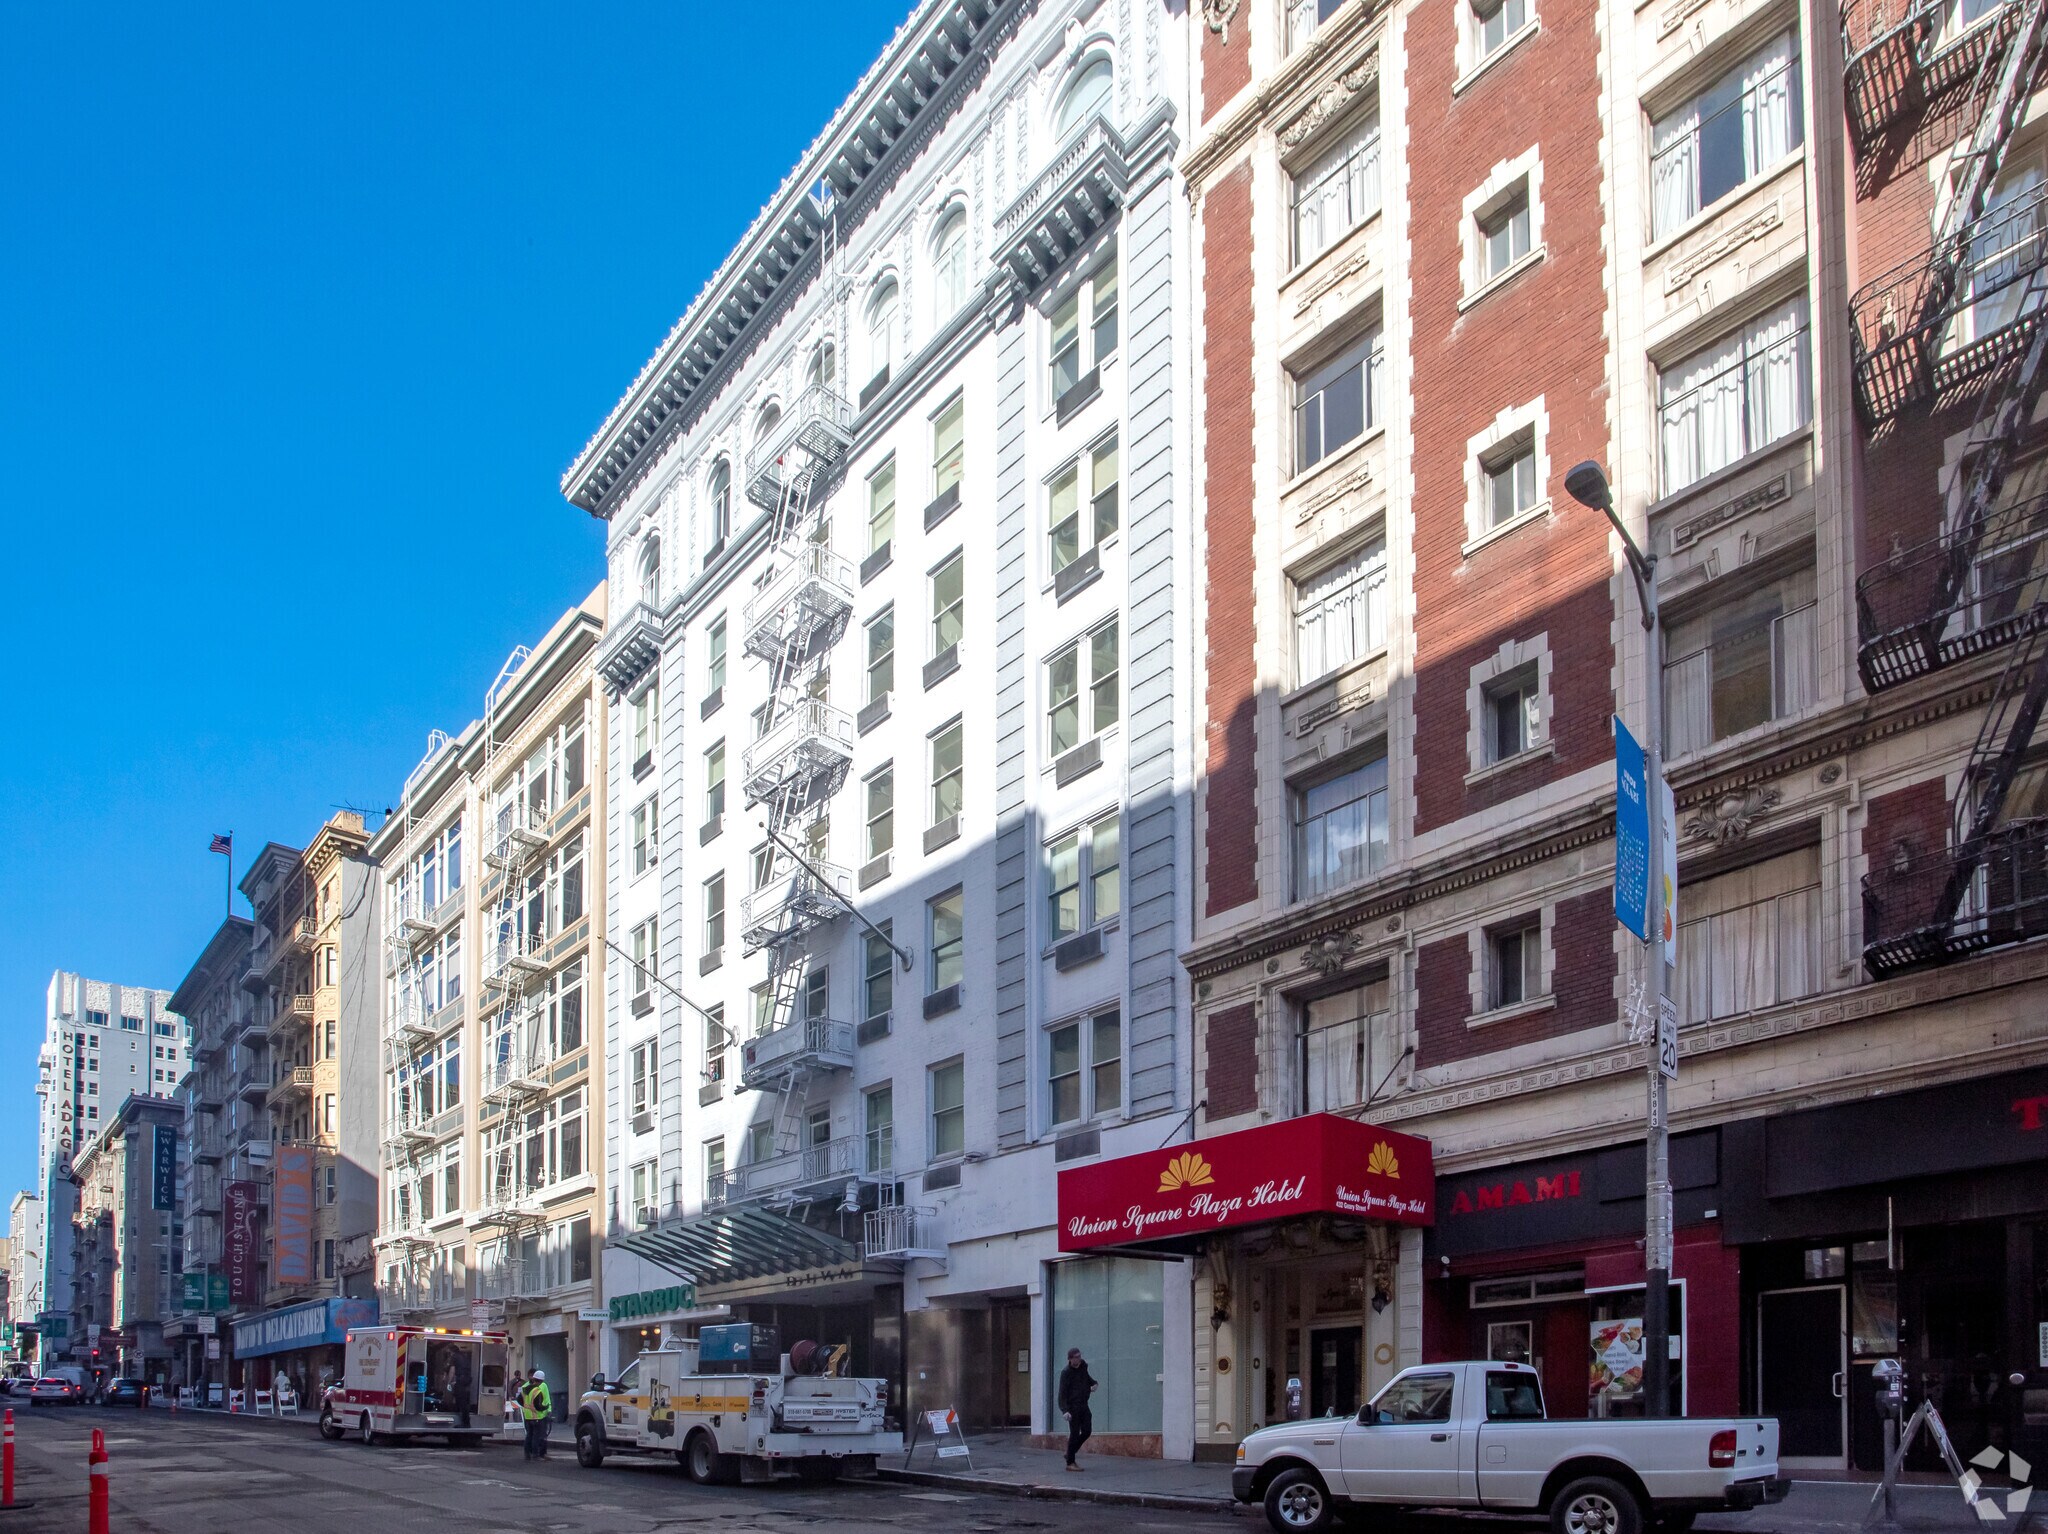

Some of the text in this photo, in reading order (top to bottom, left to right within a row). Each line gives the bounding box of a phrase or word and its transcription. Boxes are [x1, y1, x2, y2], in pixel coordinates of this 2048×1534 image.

[1661, 1003, 1676, 1023] SPEED
[1662, 1021, 1675, 1039] LIMIT
[62, 1031, 74, 1092] HOTEL
[1662, 1038, 1676, 1071] 20
[160, 1136, 171, 1204] WARWICK
[1450, 1170, 1581, 1215] AMAMI
[279, 1151, 309, 1278] DAVID'S
[1068, 1175, 1306, 1238] Union Square Plaza Hotel
[1335, 1184, 1426, 1216] Union Square Plaza Hotel
[1343, 1202, 1355, 1212] Geary
[1355, 1203, 1367, 1212] Street
[232, 1189, 245, 1297] TOUCHSTONE
[608, 1283, 696, 1321] STARBUC
[236, 1321, 263, 1350] DAVID'S
[265, 1305, 326, 1344] DELICATESSEN
